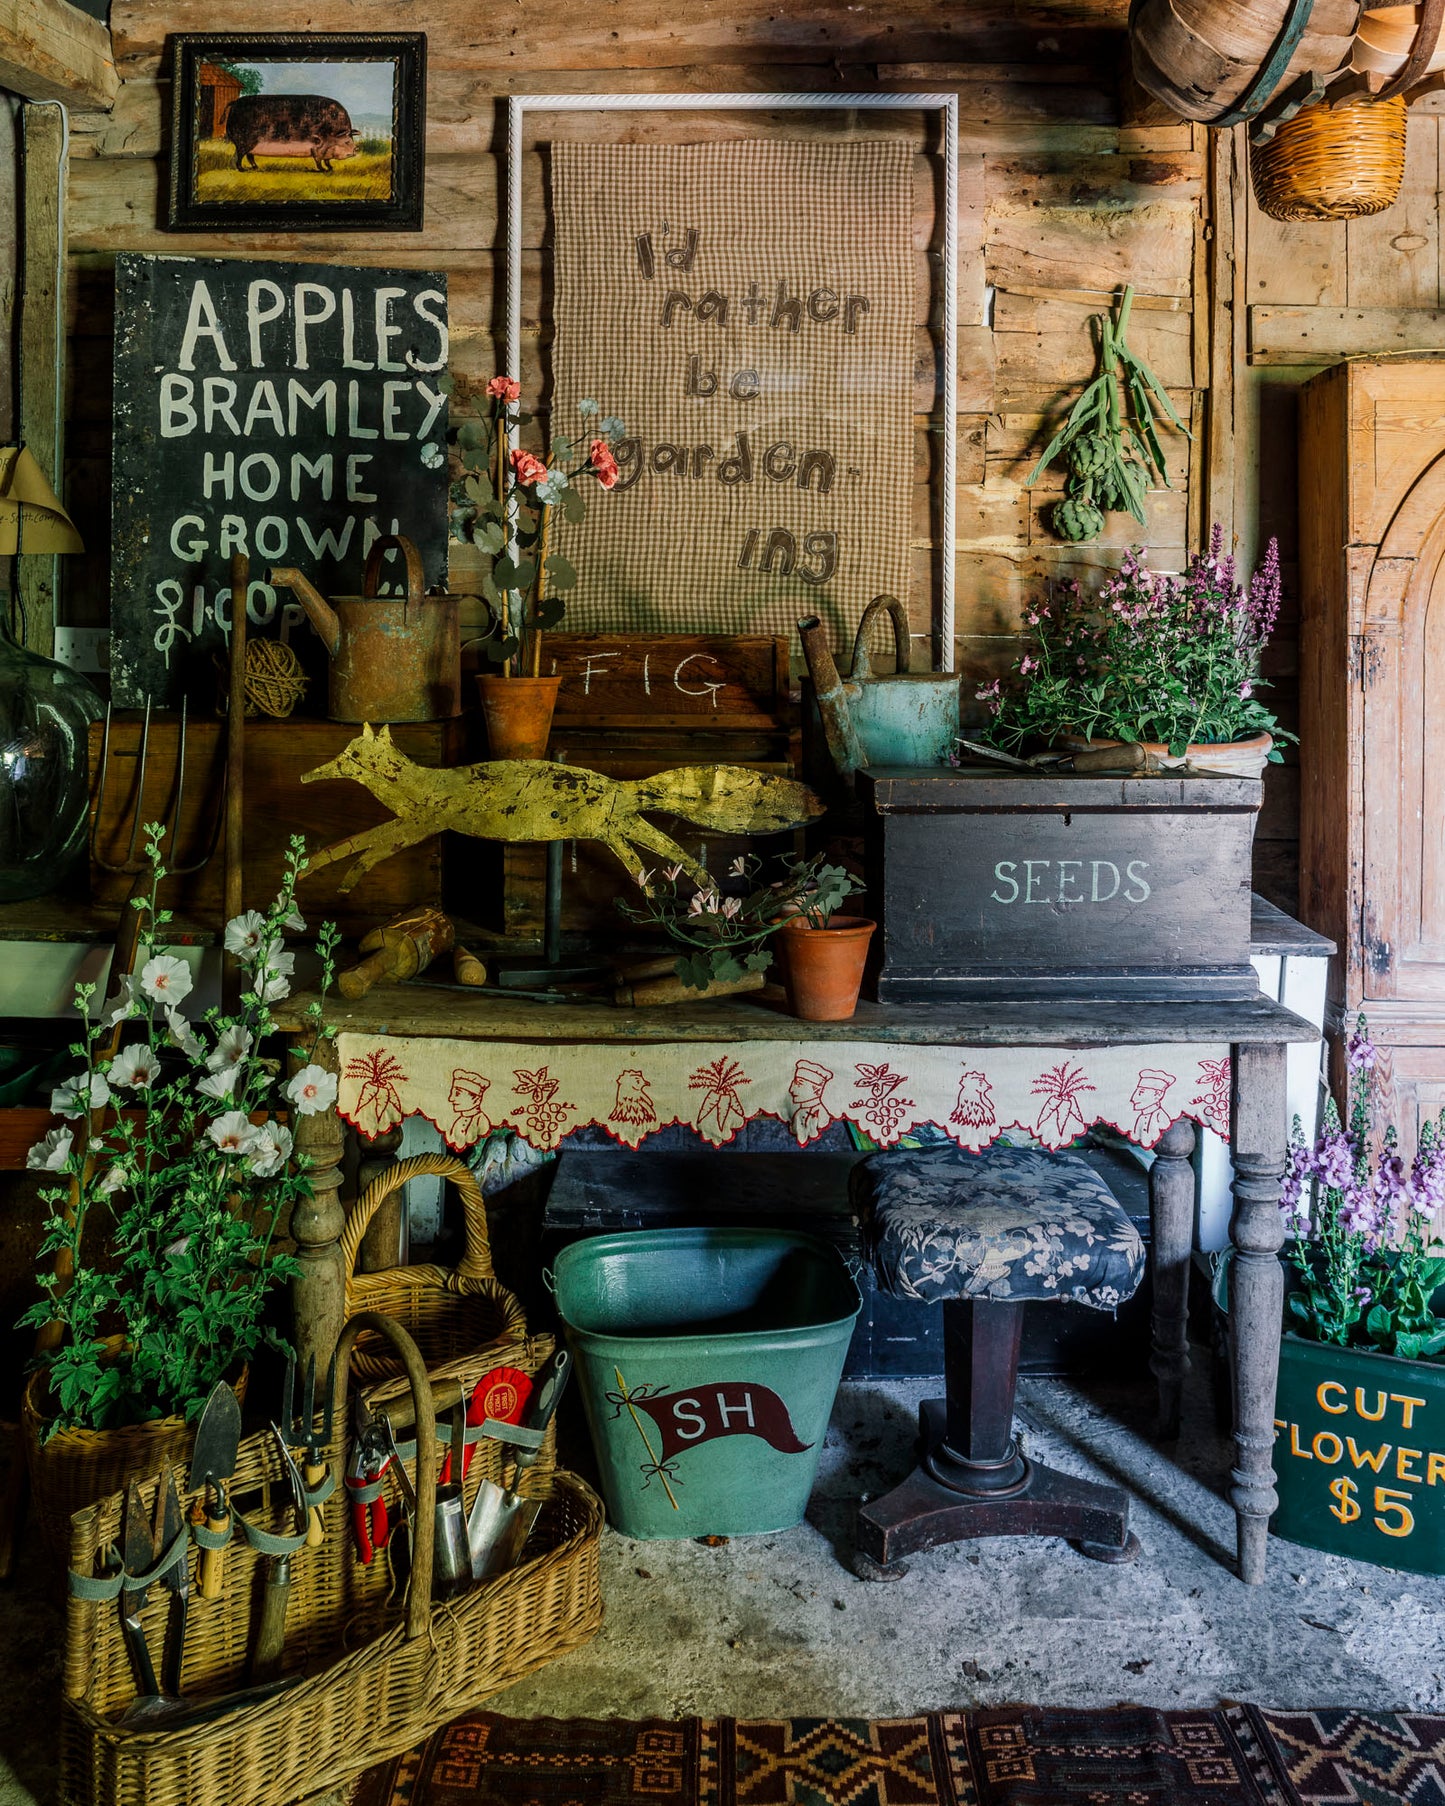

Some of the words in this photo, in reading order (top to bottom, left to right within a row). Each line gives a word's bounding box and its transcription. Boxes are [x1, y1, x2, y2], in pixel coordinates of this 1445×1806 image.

[635, 220, 700, 280] I'd
[178, 279, 448, 371] APPLES
[661, 279, 870, 335] rather
[687, 354, 761, 400] be
[160, 373, 447, 440] BRAMLEY
[203, 452, 378, 502] HOME
[170, 515, 399, 562] GROWN
[737, 527, 839, 584] ing
[578, 652, 727, 708] FIG
[990, 860, 1152, 904] SEEDS
[672, 1392, 755, 1439] SH
[1316, 1381, 1426, 1429] CUT
[1329, 1476, 1415, 1537] $5
